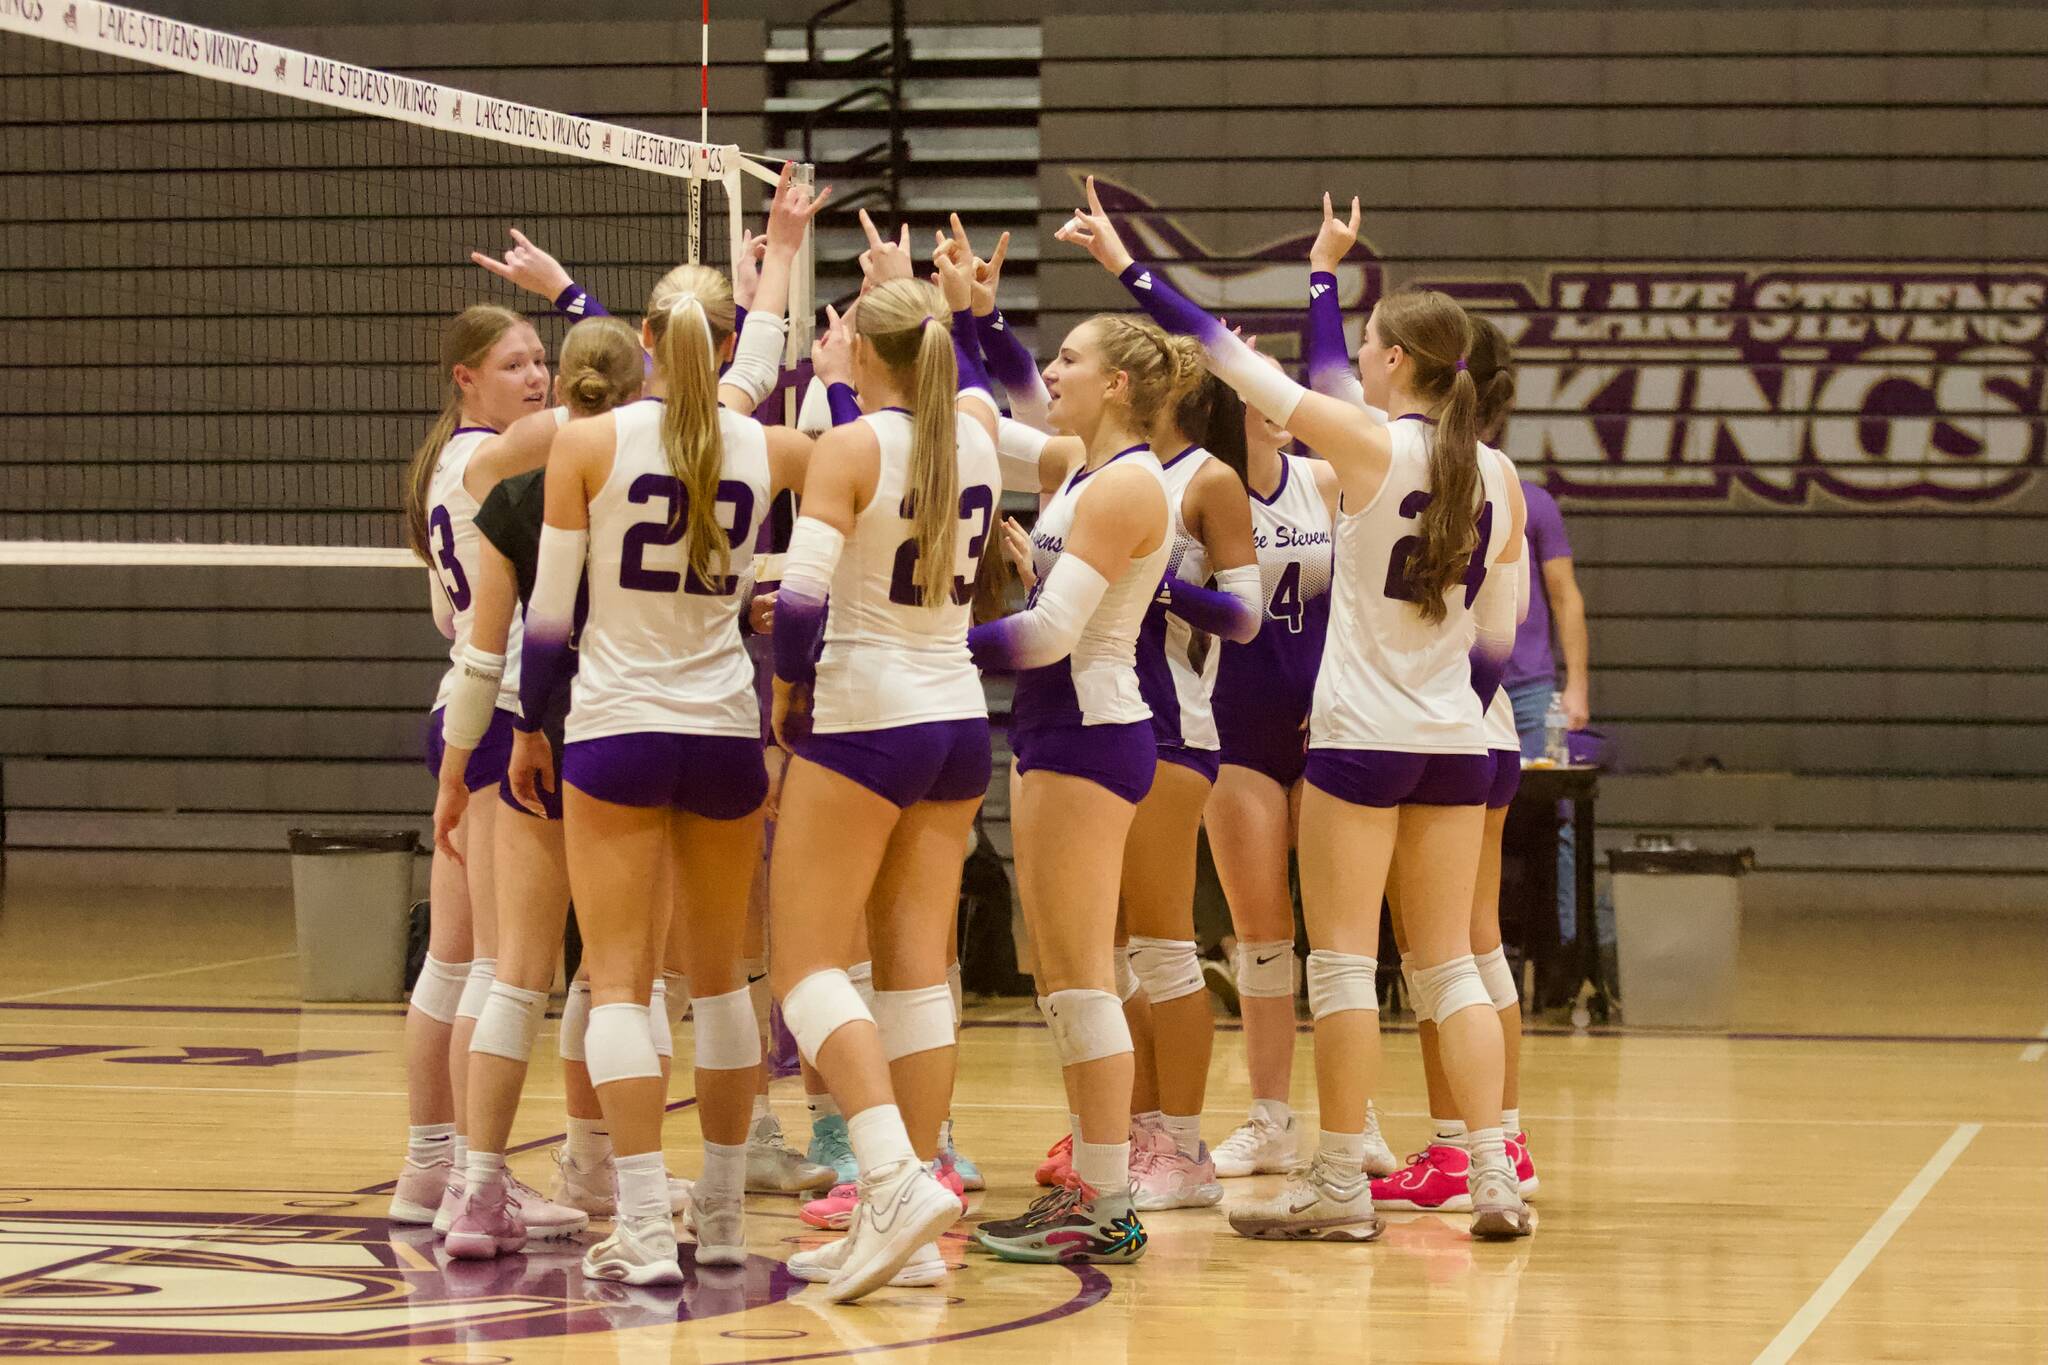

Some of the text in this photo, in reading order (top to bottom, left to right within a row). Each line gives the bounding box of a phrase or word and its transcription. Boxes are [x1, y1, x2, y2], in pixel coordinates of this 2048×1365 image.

[99, 7, 258, 75] LAKE STEVENS VIKINGS
[303, 57, 438, 116] LAKE STEVENS VIKINGS
[475, 98, 503, 131] LAKE
[1551, 281, 2046, 342] LAKE STEVENS
[619, 473, 754, 595] 22
[1268, 561, 1303, 633] 4
